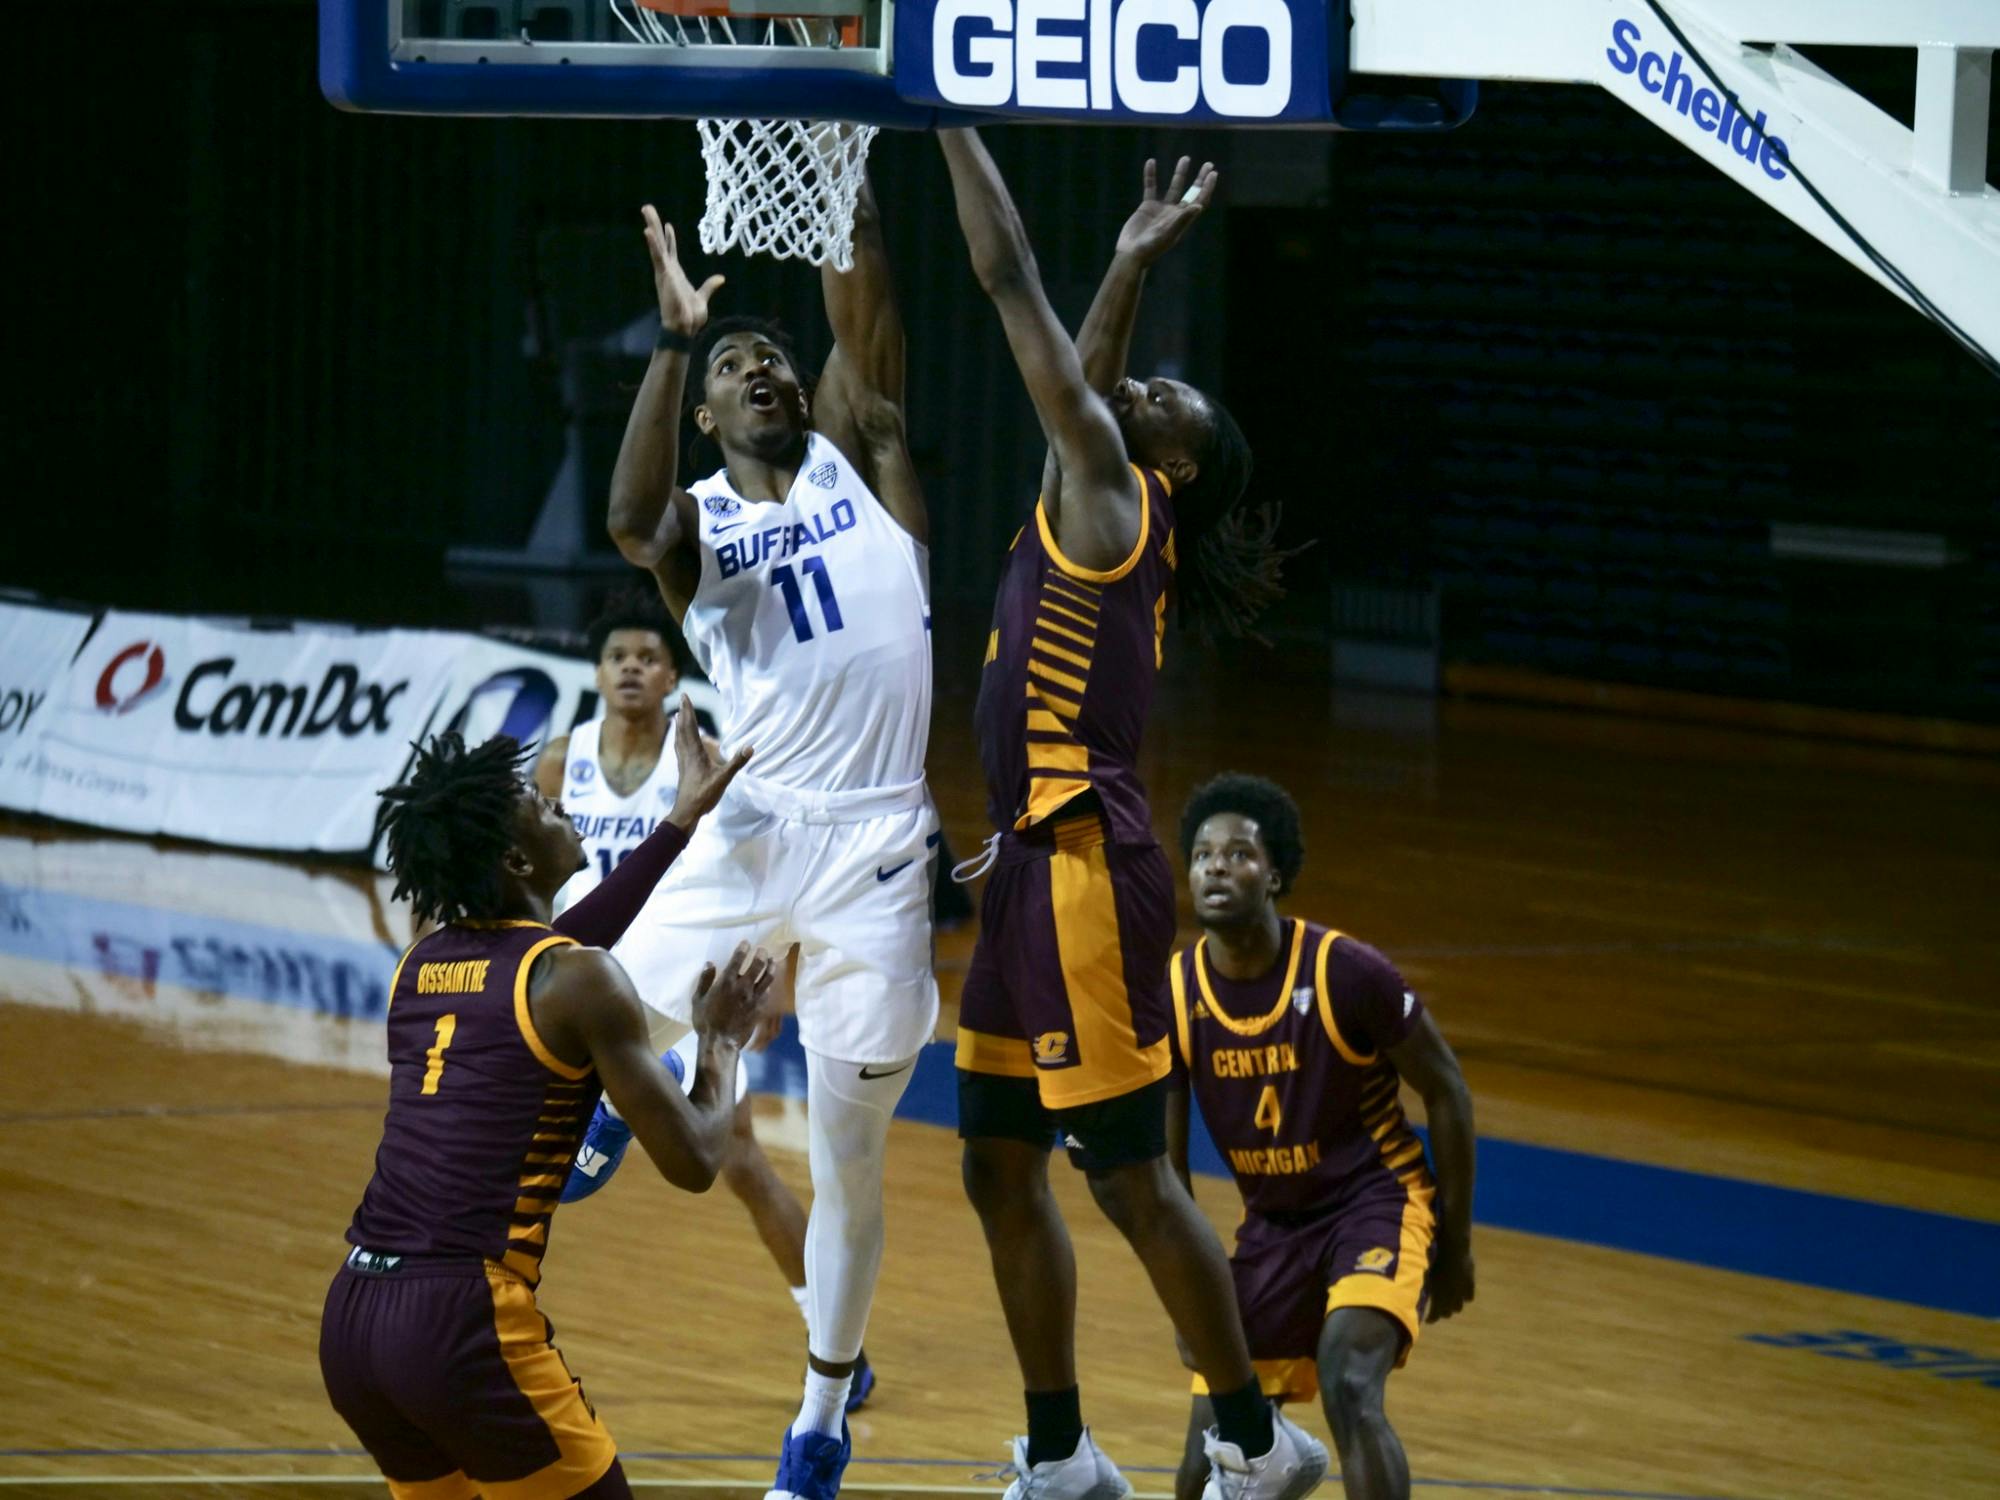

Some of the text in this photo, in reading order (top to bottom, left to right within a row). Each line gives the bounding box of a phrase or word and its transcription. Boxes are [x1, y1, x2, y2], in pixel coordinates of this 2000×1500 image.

[933, 0, 1292, 117] GEICO
[1606, 19, 1790, 181] Schelde
[715, 498, 857, 580] BUFFALO
[770, 555, 844, 644] 11
[420, 1014, 456, 1095] 1
[1254, 1085, 1281, 1137] 4
